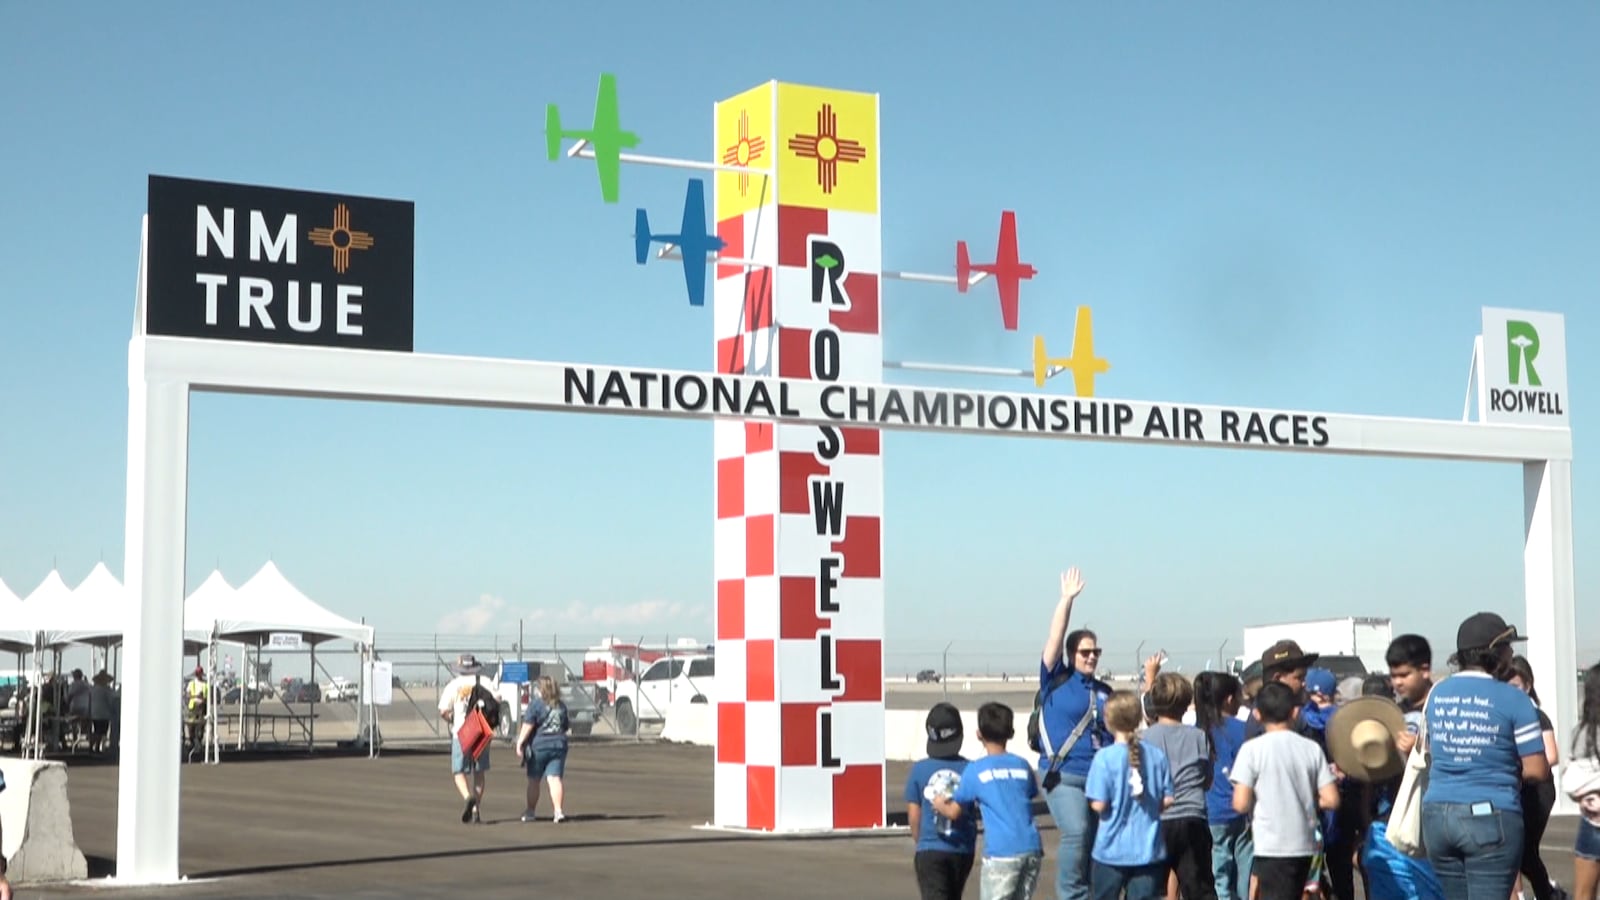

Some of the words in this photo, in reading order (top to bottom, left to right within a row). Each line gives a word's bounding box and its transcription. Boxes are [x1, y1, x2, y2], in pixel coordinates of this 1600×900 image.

[196, 204, 297, 264] NM
[196, 273, 363, 336] TRUE
[564, 367, 800, 417] NATIONAL
[820, 385, 1133, 436] CHAMPIONSHIP
[1143, 405, 1205, 440] AIR
[1221, 410, 1330, 447] RACES
[1490, 388, 1563, 415] ROSWELL
